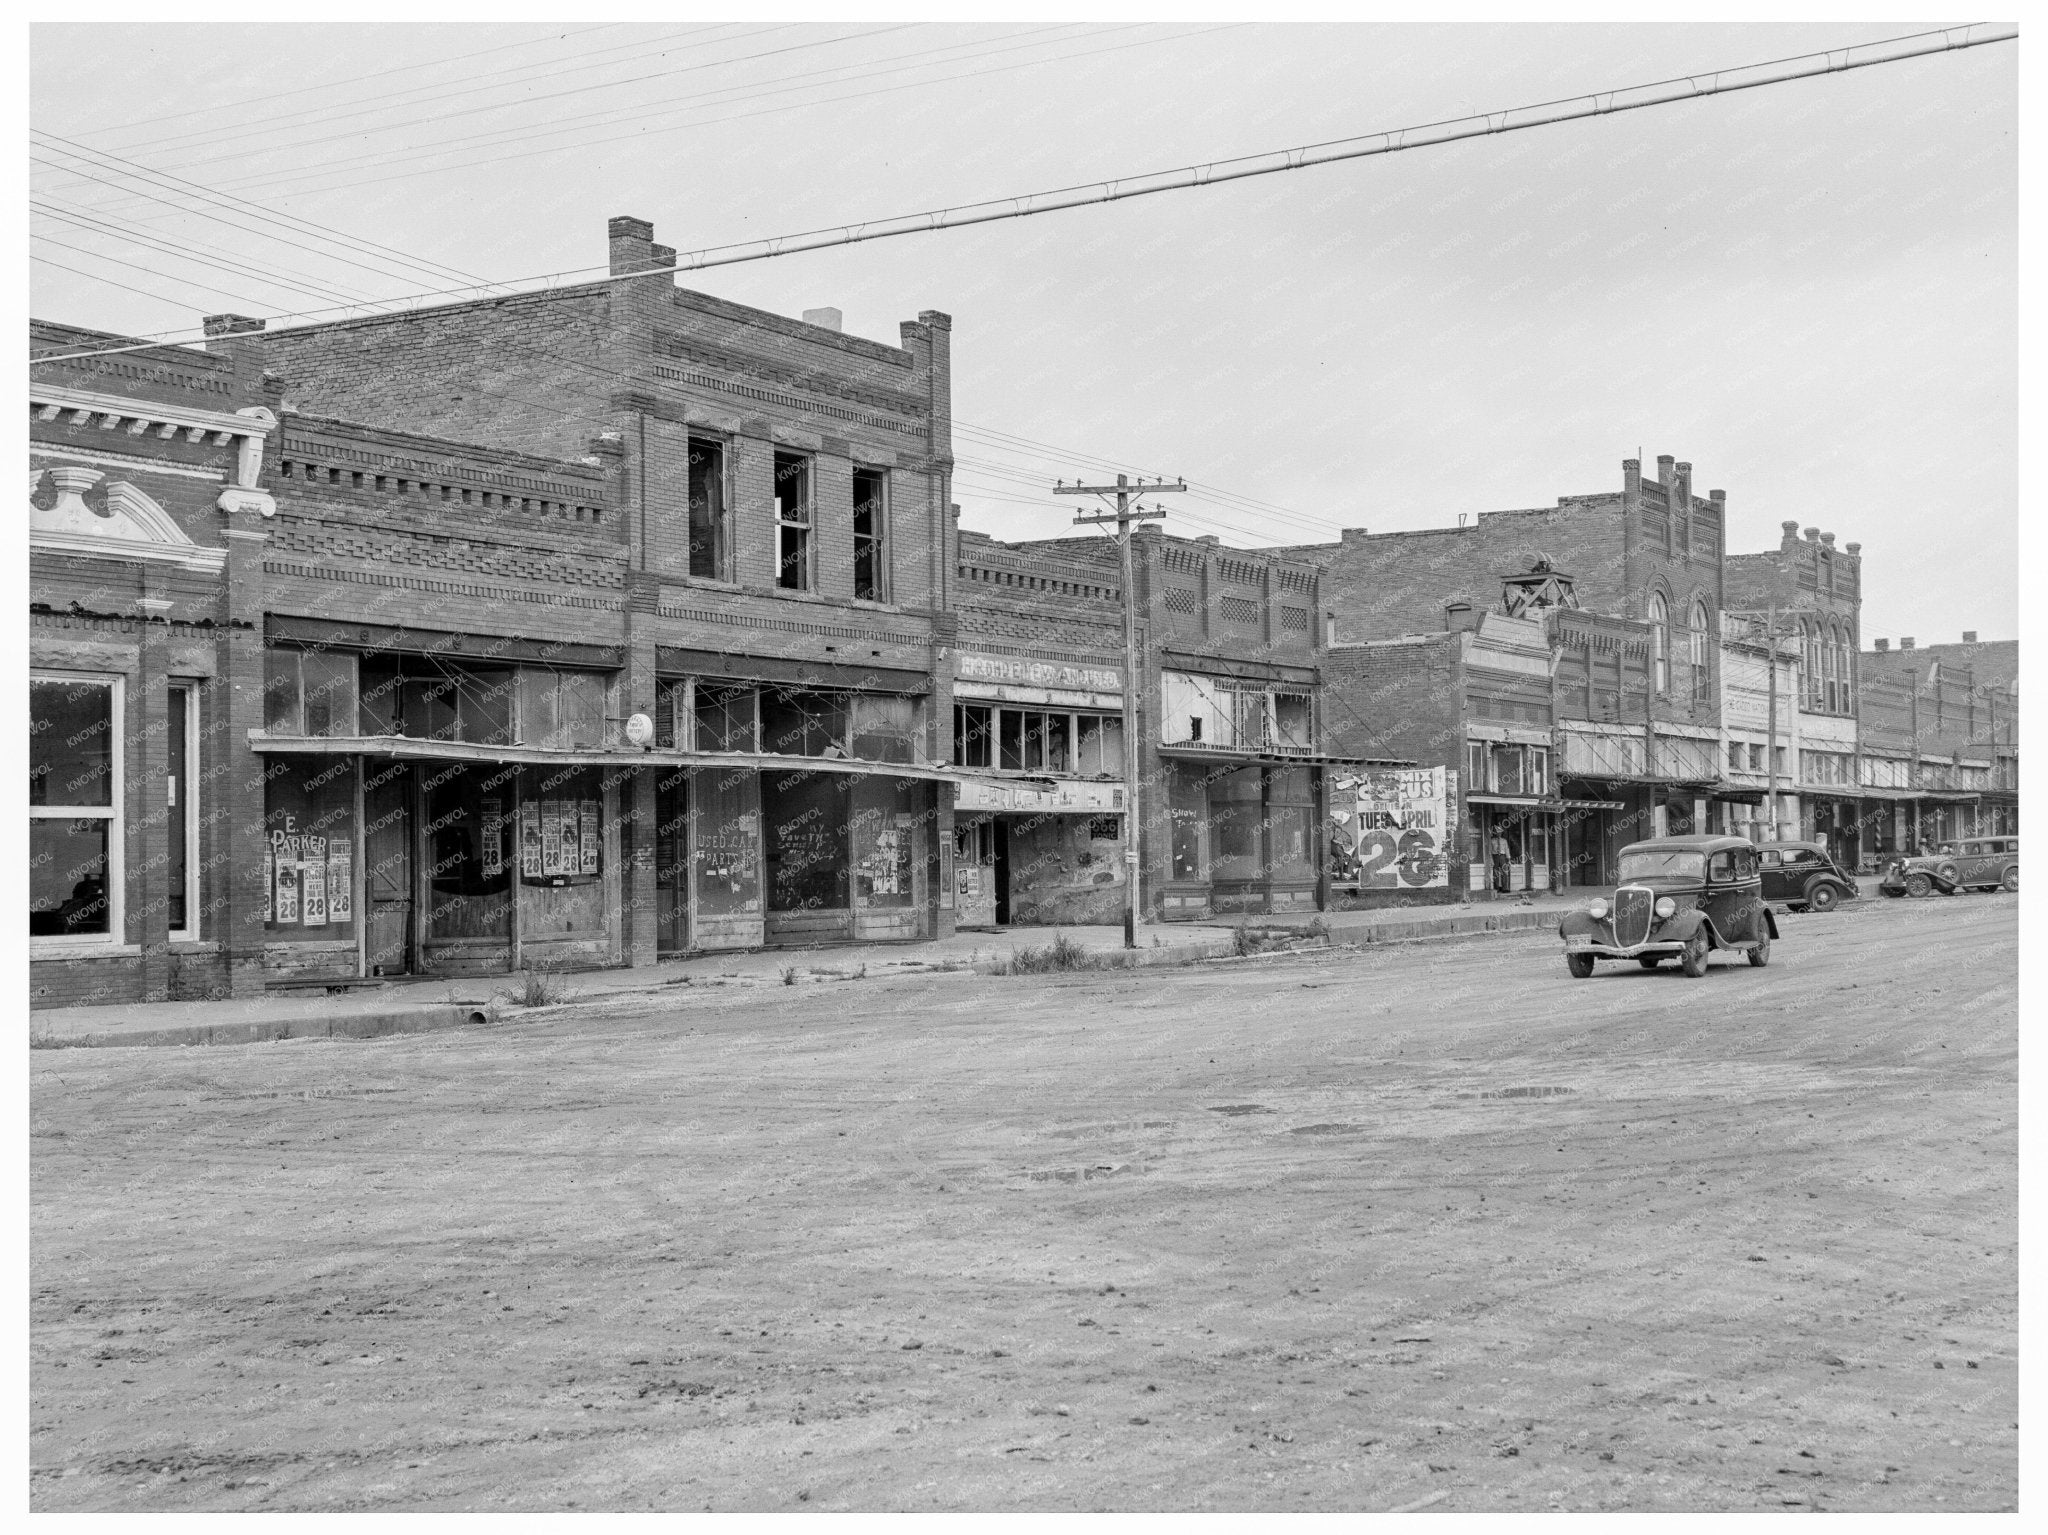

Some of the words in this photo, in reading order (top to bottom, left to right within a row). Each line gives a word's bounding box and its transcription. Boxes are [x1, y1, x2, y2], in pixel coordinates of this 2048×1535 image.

[1400, 771, 1432, 781] MIX
[270, 829, 327, 853] PARKER
[483, 850, 499, 866] 28
[525, 857, 540, 873] 28
[544, 851, 560, 867] 28
[280, 900, 297, 918] 28
[307, 898, 324, 916] 28
